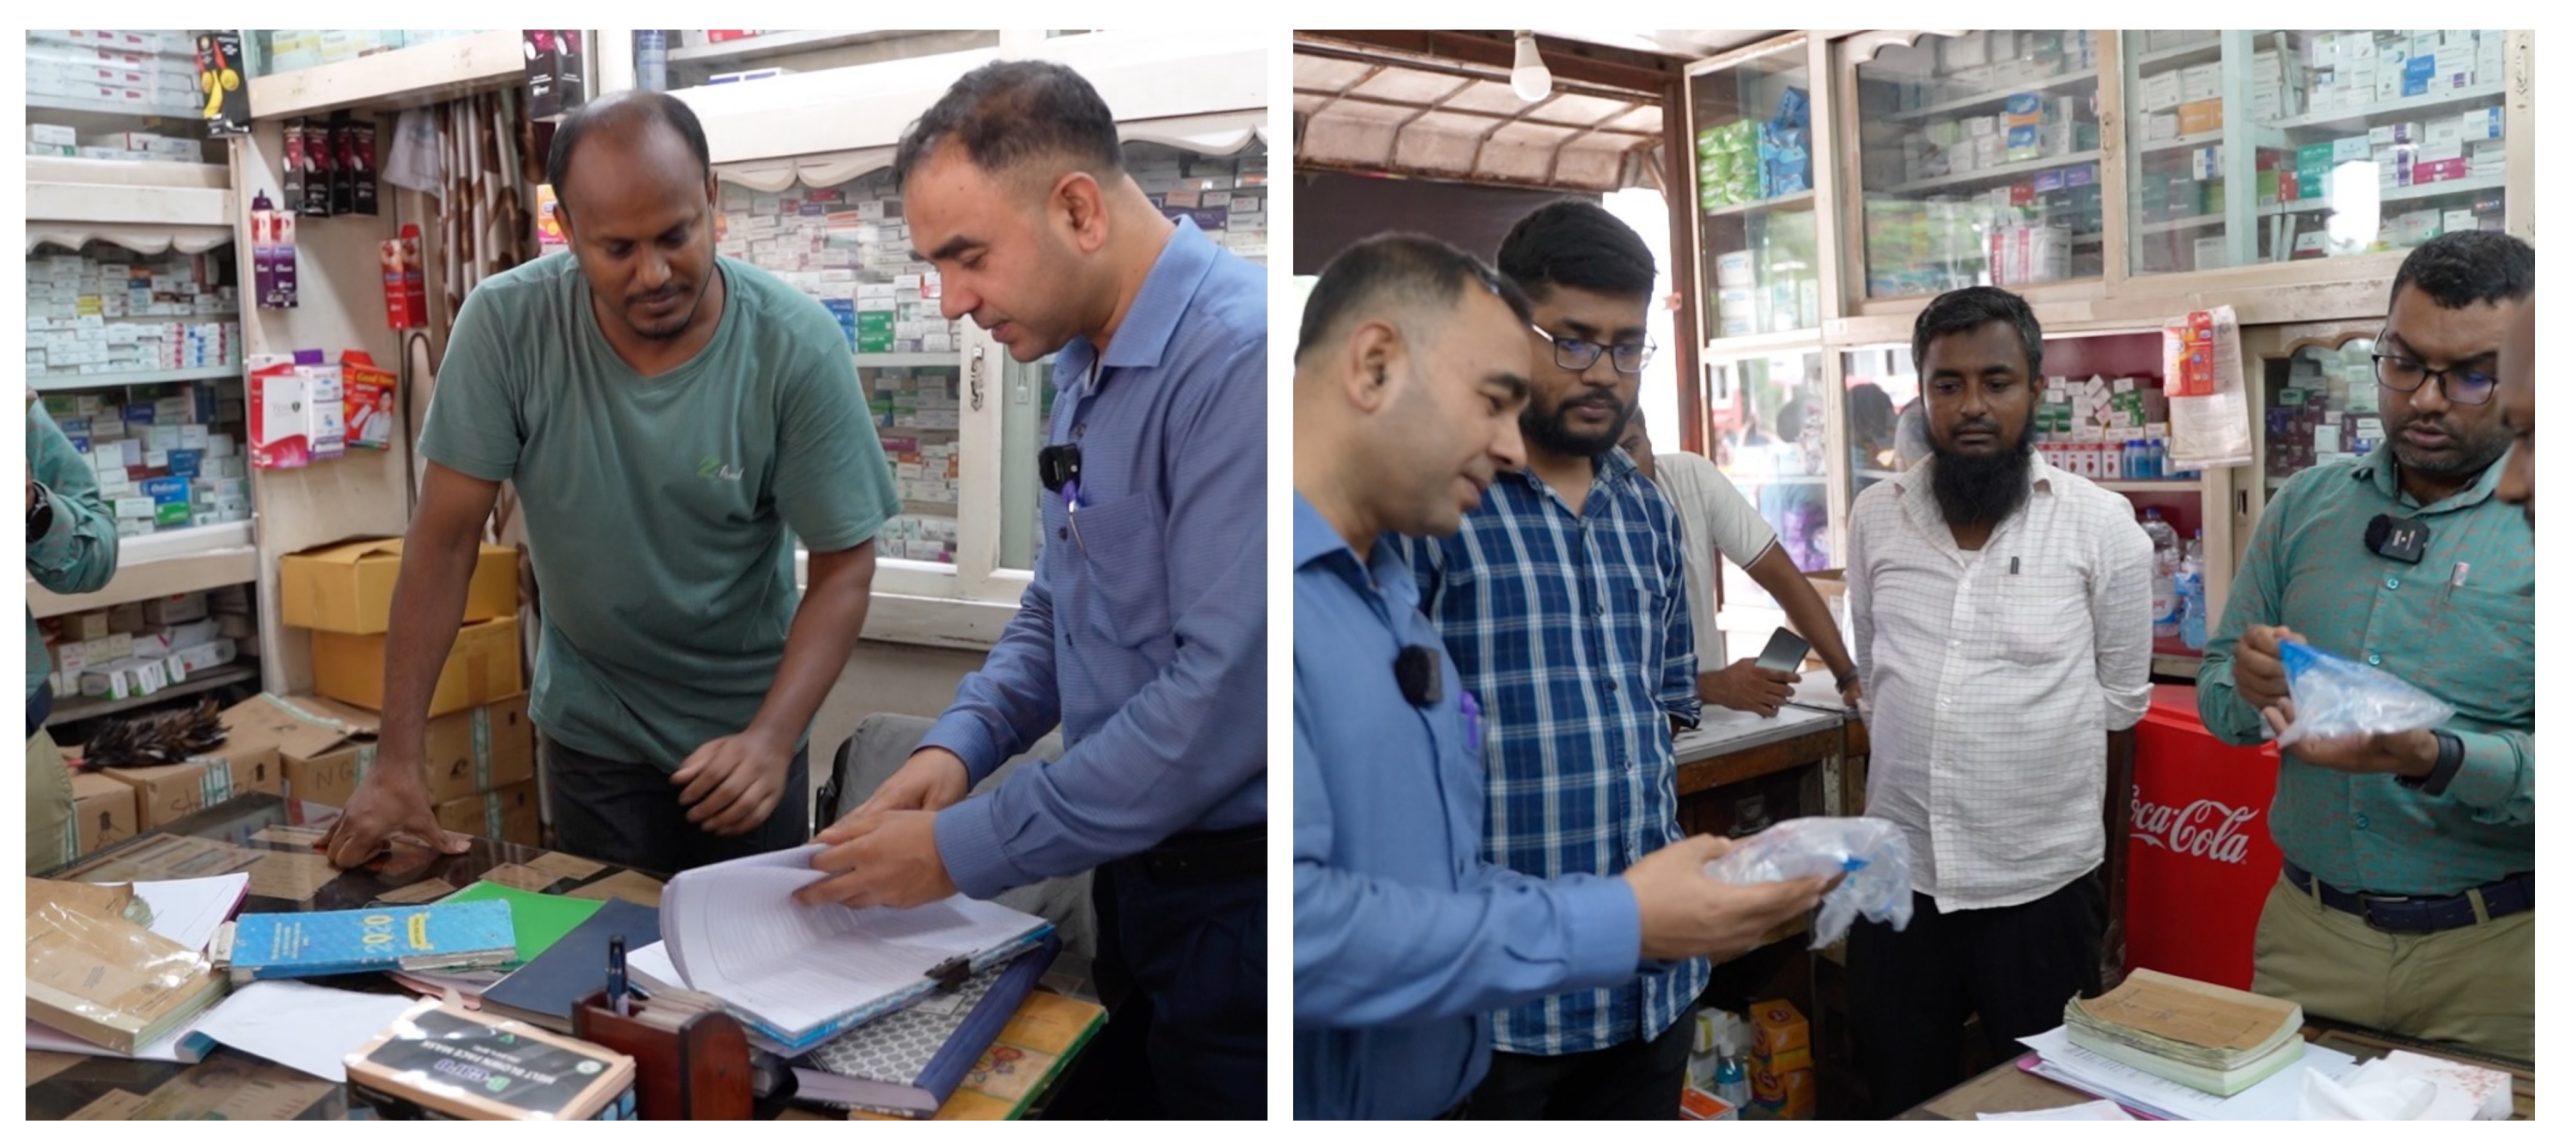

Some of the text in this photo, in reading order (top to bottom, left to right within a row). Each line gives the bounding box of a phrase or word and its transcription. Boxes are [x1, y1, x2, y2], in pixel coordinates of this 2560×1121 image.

[2130, 784, 2260, 864] oca-Cola
[363, 914, 394, 954] 2020
[419, 1039, 456, 1055] MASK
[452, 1048, 483, 1064] FACE
[480, 1056, 526, 1078] BLOWN
